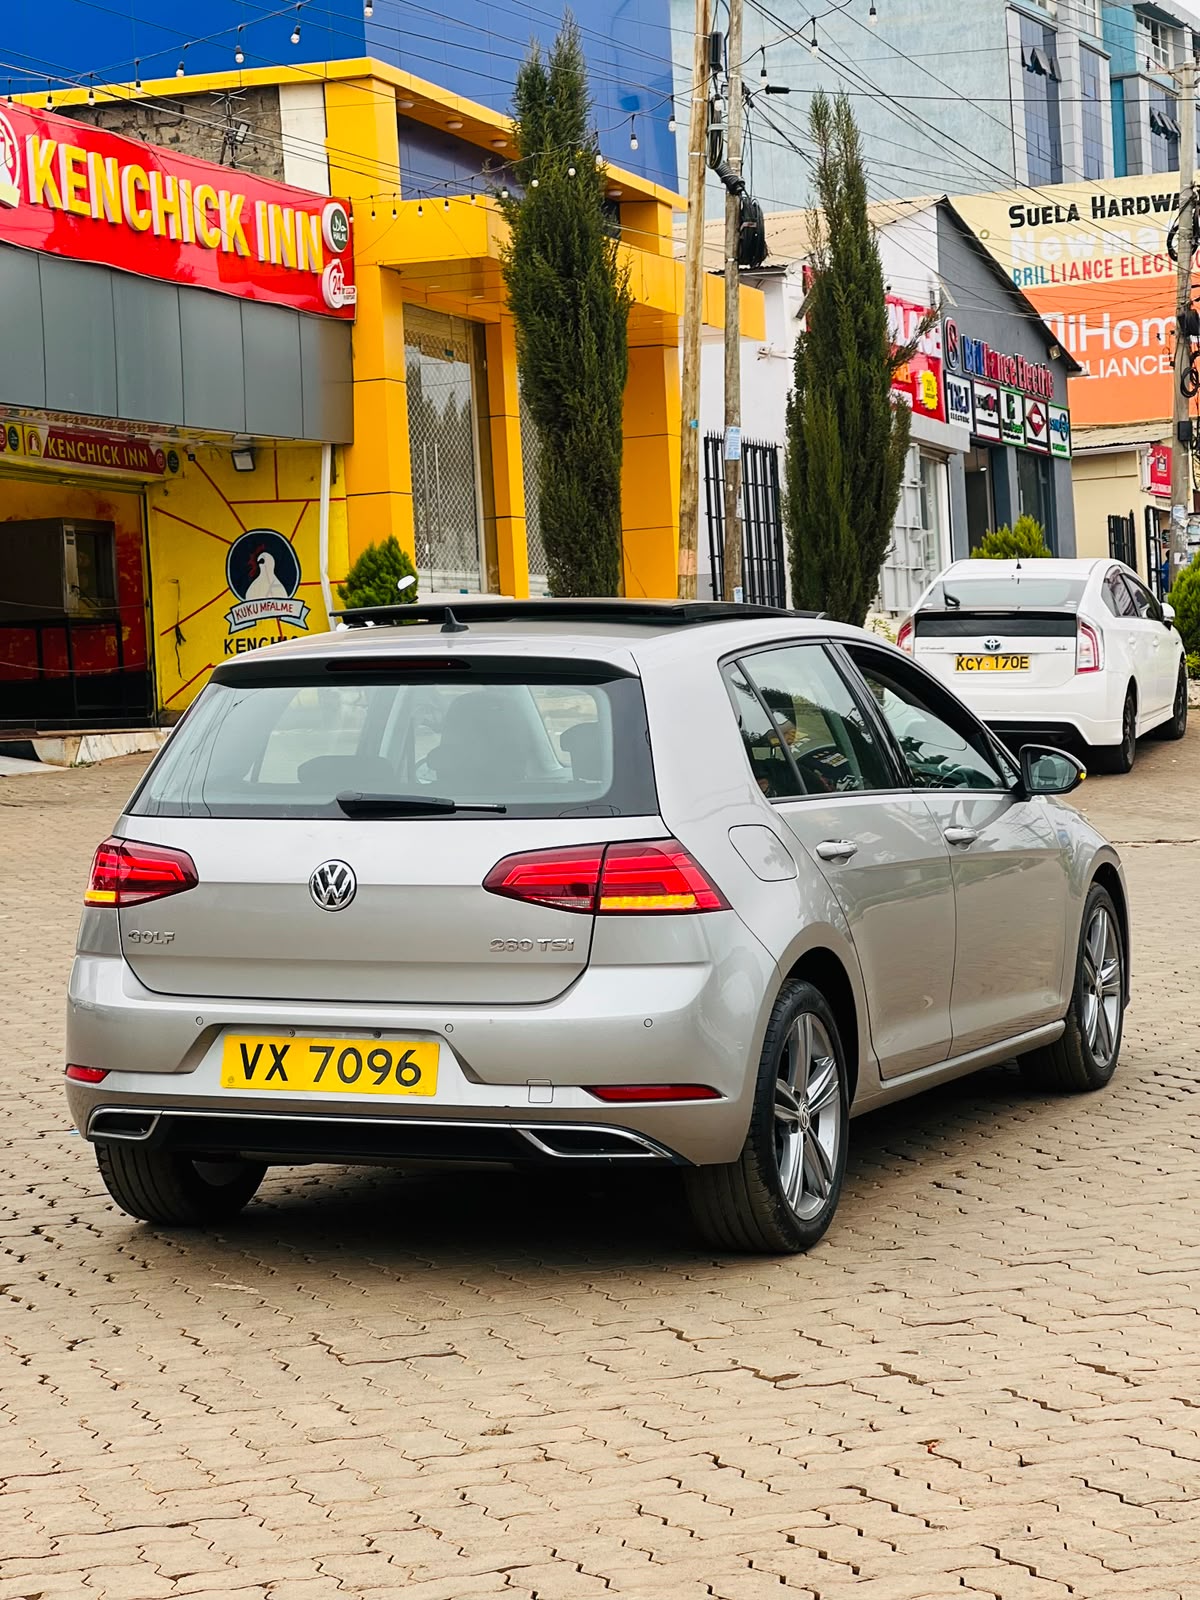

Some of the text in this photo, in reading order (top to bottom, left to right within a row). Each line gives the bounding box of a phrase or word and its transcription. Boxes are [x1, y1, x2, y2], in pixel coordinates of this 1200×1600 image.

[26, 134, 324, 274] KENCHICK INN
[1008, 192, 1180, 228] SUELA HARDWA
[1010, 227, 1164, 265] Newma
[1013, 257, 1119, 287] BRILLIANCE
[47, 437, 121, 465] KENCHICK
[124, 448, 149, 467] INN
[234, 601, 293, 621] KUKU MFALME
[224, 635, 298, 655] KENC
[956, 655, 1029, 672] KCY 170E
[128, 929, 175, 945] GOLF
[239, 1042, 422, 1088] VX 7096
